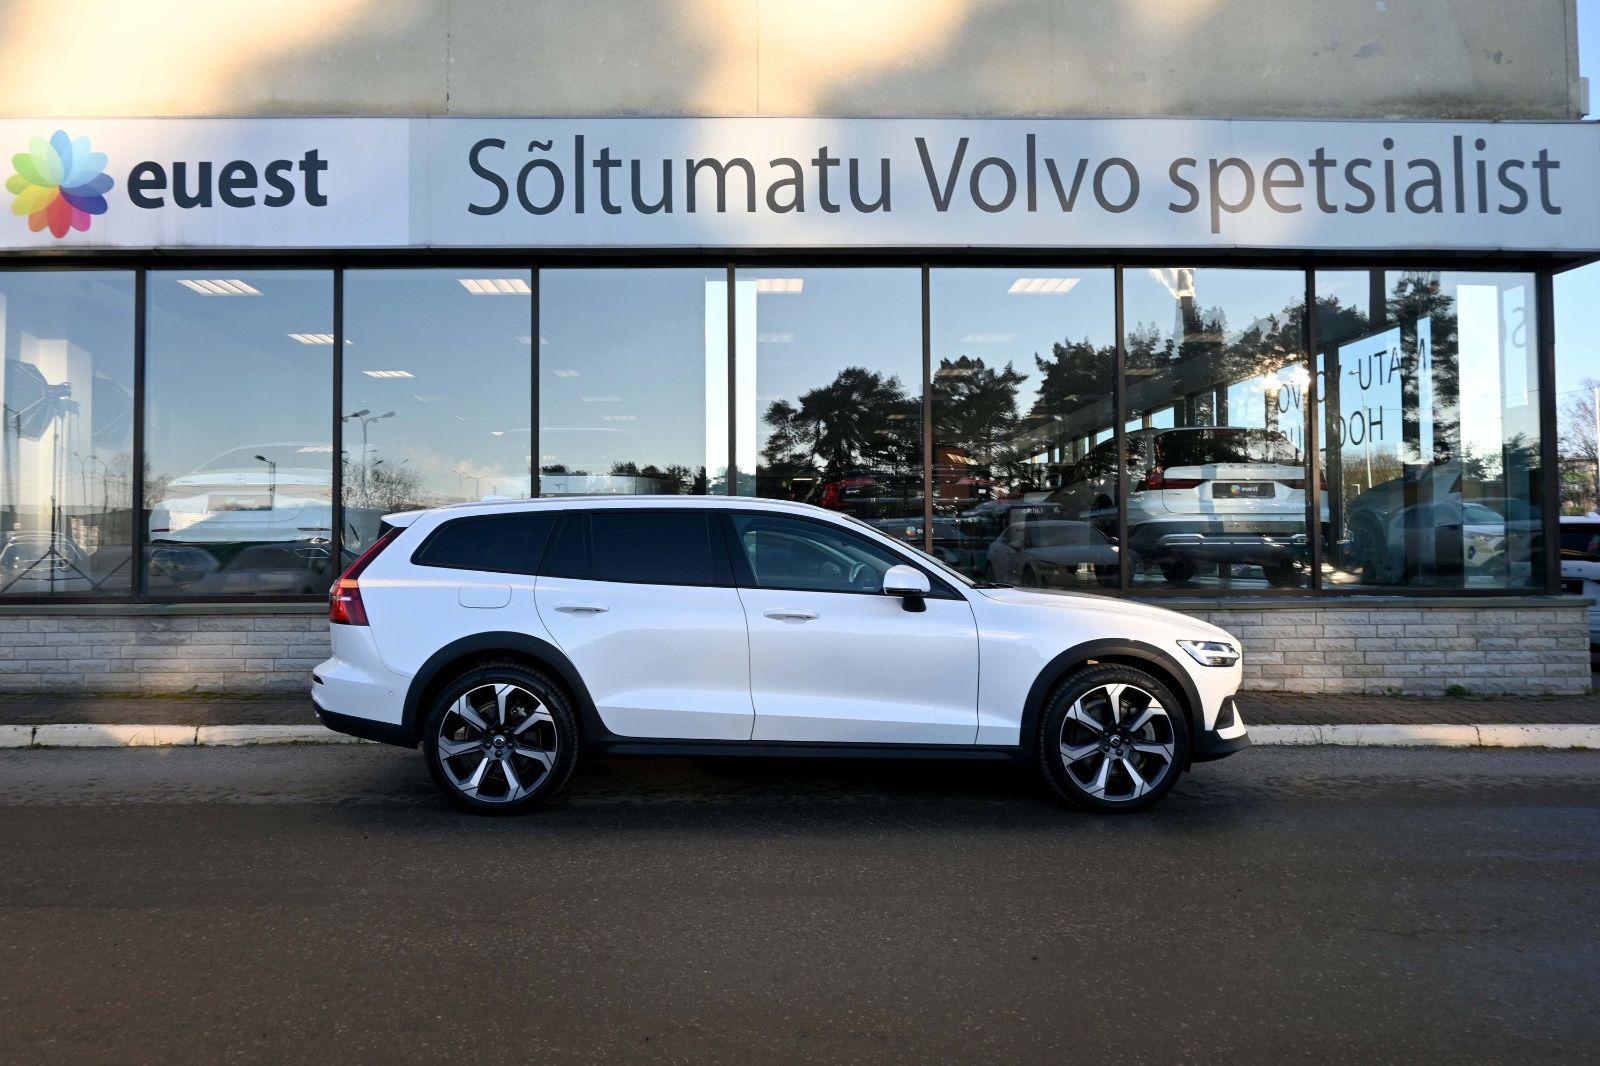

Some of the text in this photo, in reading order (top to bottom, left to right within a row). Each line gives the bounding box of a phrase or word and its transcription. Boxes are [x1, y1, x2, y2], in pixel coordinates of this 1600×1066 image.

[128, 149, 327, 210] euest
[468, 133, 1562, 234] Sõltumatu Volvo spetsialist
